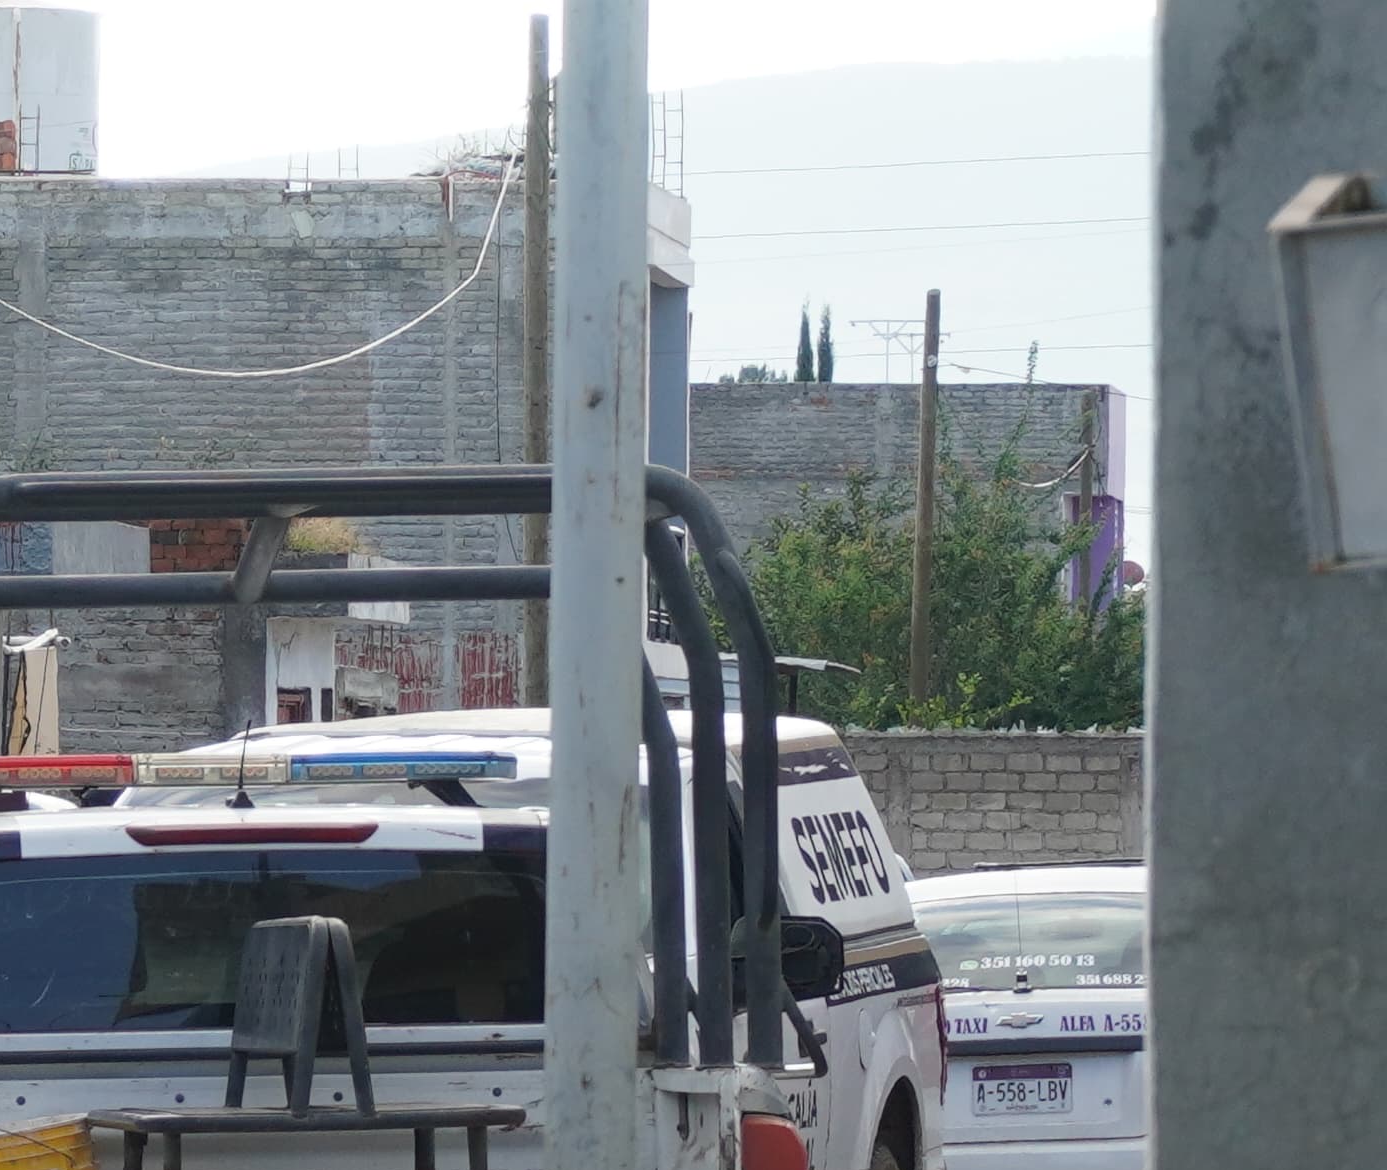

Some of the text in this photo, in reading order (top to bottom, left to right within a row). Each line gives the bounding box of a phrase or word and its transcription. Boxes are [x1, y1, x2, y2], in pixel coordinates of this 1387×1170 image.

[791, 810, 890, 904] SEMEFO
[980, 954, 1095, 969] 351 160 50 13
[1076, 974, 1100, 985] 351
[1102, 974, 1132, 985] 688
[954, 1017, 988, 1034] TAXI
[1060, 1015, 1095, 1032] ALFA
[1104, 1013, 1146, 1032] A-55
[977, 1079, 1067, 1104] A-558-LBV
